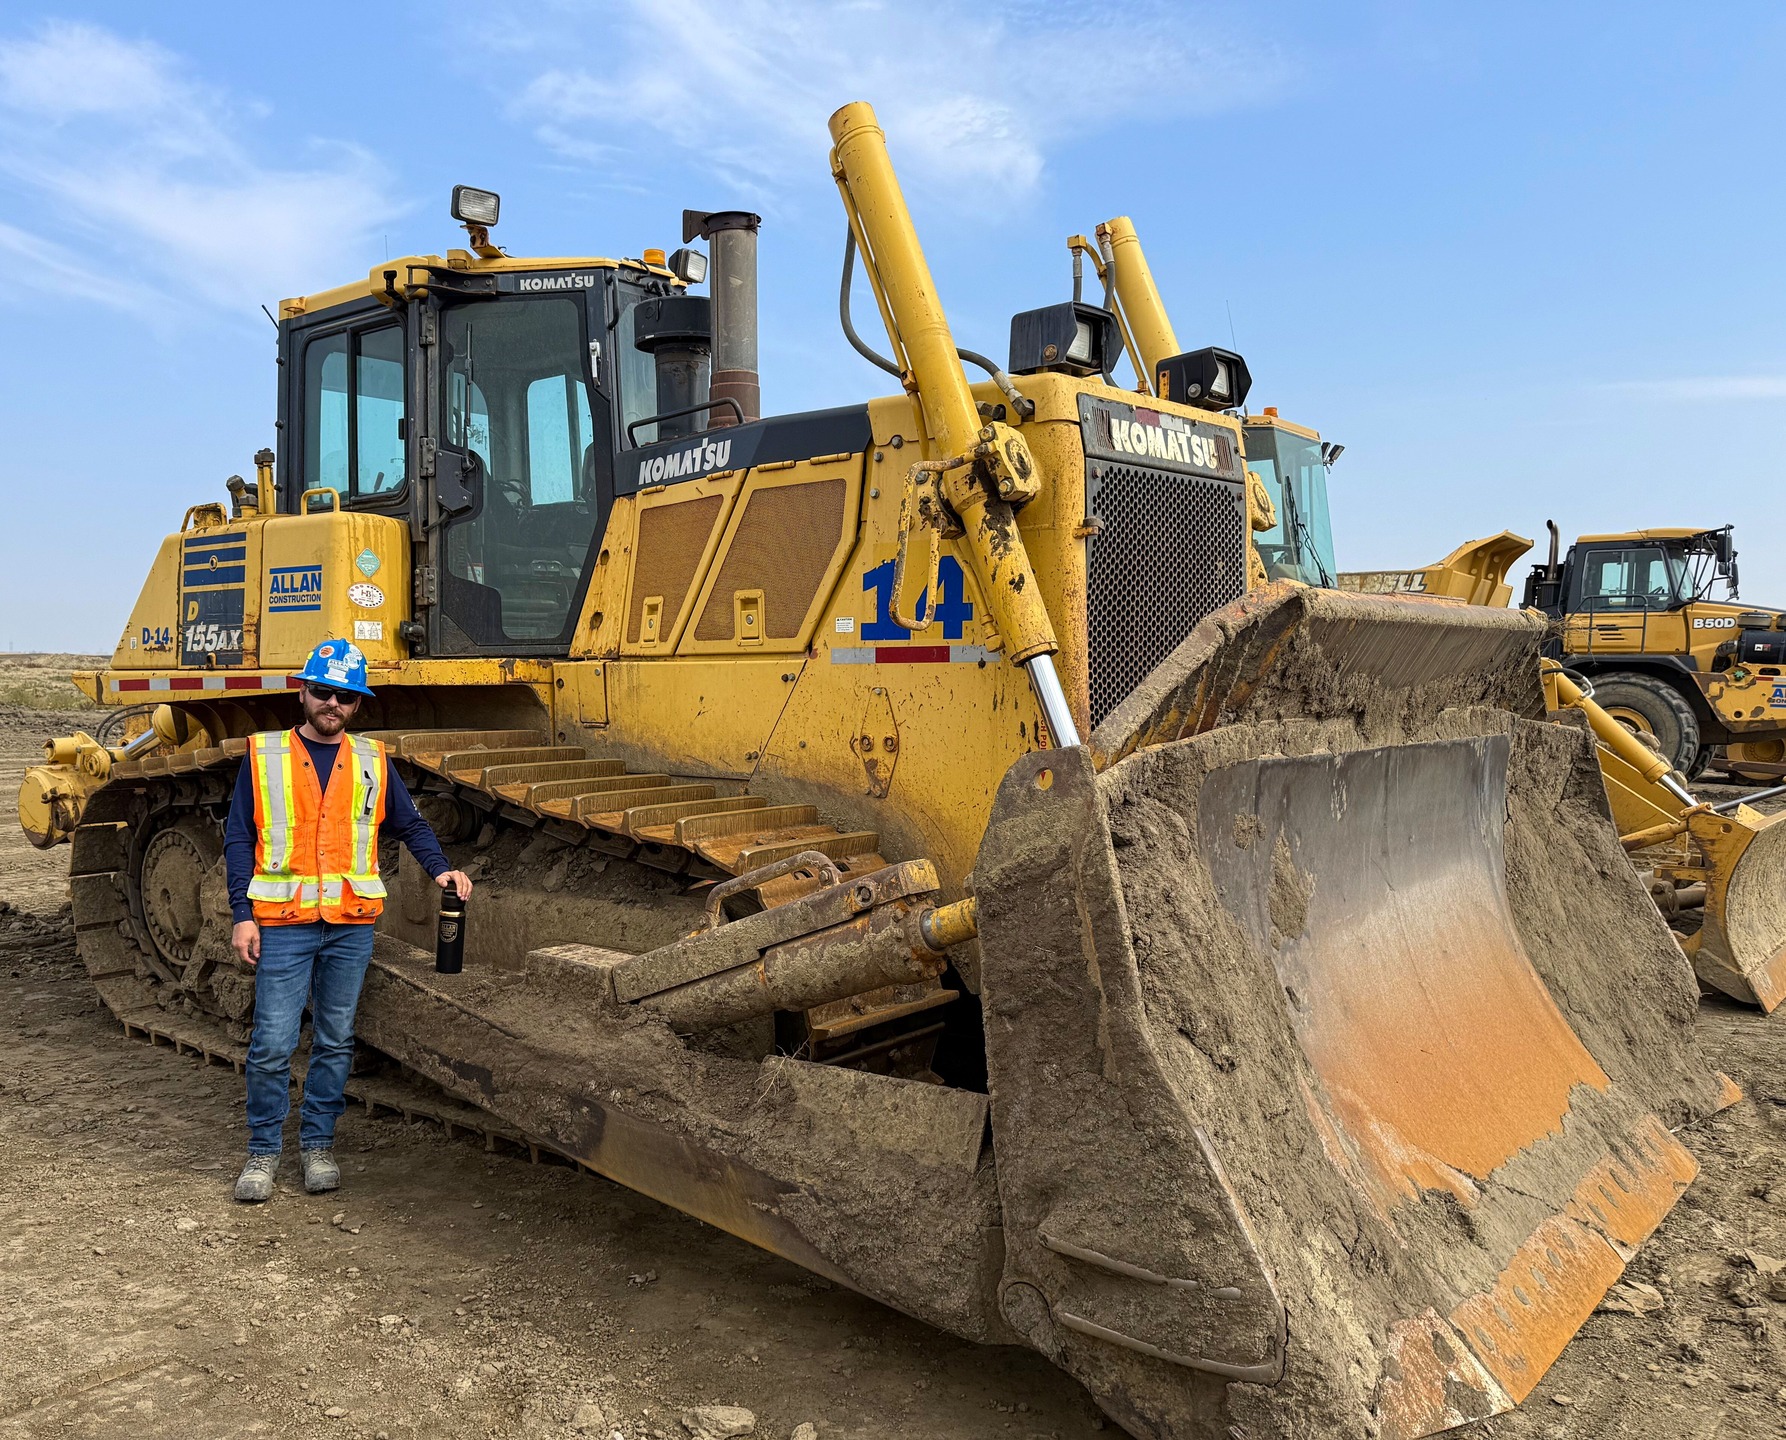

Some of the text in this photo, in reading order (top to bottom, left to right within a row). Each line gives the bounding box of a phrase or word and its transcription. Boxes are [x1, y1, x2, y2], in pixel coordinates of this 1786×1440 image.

[520, 273, 594, 291] KOMATSU
[1110, 418, 1218, 469] KOMATSU
[638, 438, 732, 485] KOMATSU
[270, 572, 322, 594] ALLAN
[269, 594, 322, 604] CONSTRUCTION
[861, 555, 973, 641] 14
[187, 600, 199, 621] D
[1693, 617, 1736, 629] B50D
[142, 627, 169, 645] D-14
[186, 623, 242, 652] 155AX
